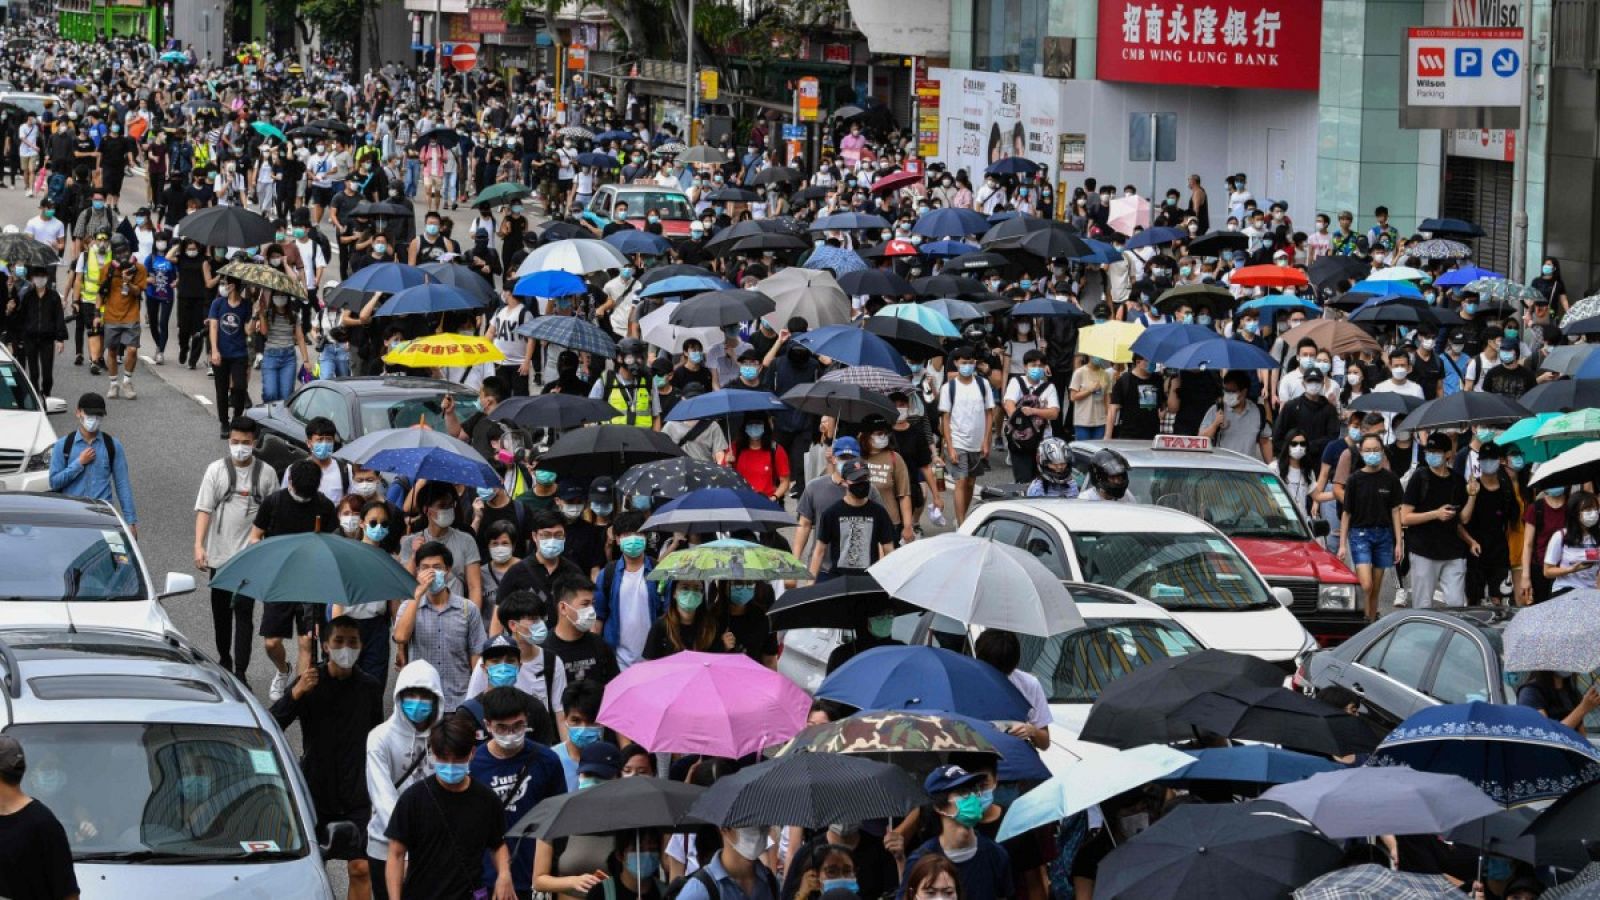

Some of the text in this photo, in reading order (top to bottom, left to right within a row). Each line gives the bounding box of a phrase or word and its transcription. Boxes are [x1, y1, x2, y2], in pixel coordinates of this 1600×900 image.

[1479, 0, 1519, 27] Wilso
[1122, 2, 1281, 48] 招商永隆銀行
[1122, 48, 1279, 66] CMB WING LUNG BANK
[1460, 51, 1477, 73] P
[1417, 79, 1446, 88] Wilson
[1417, 90, 1445, 100] Parking
[1162, 437, 1208, 449] TAXI
